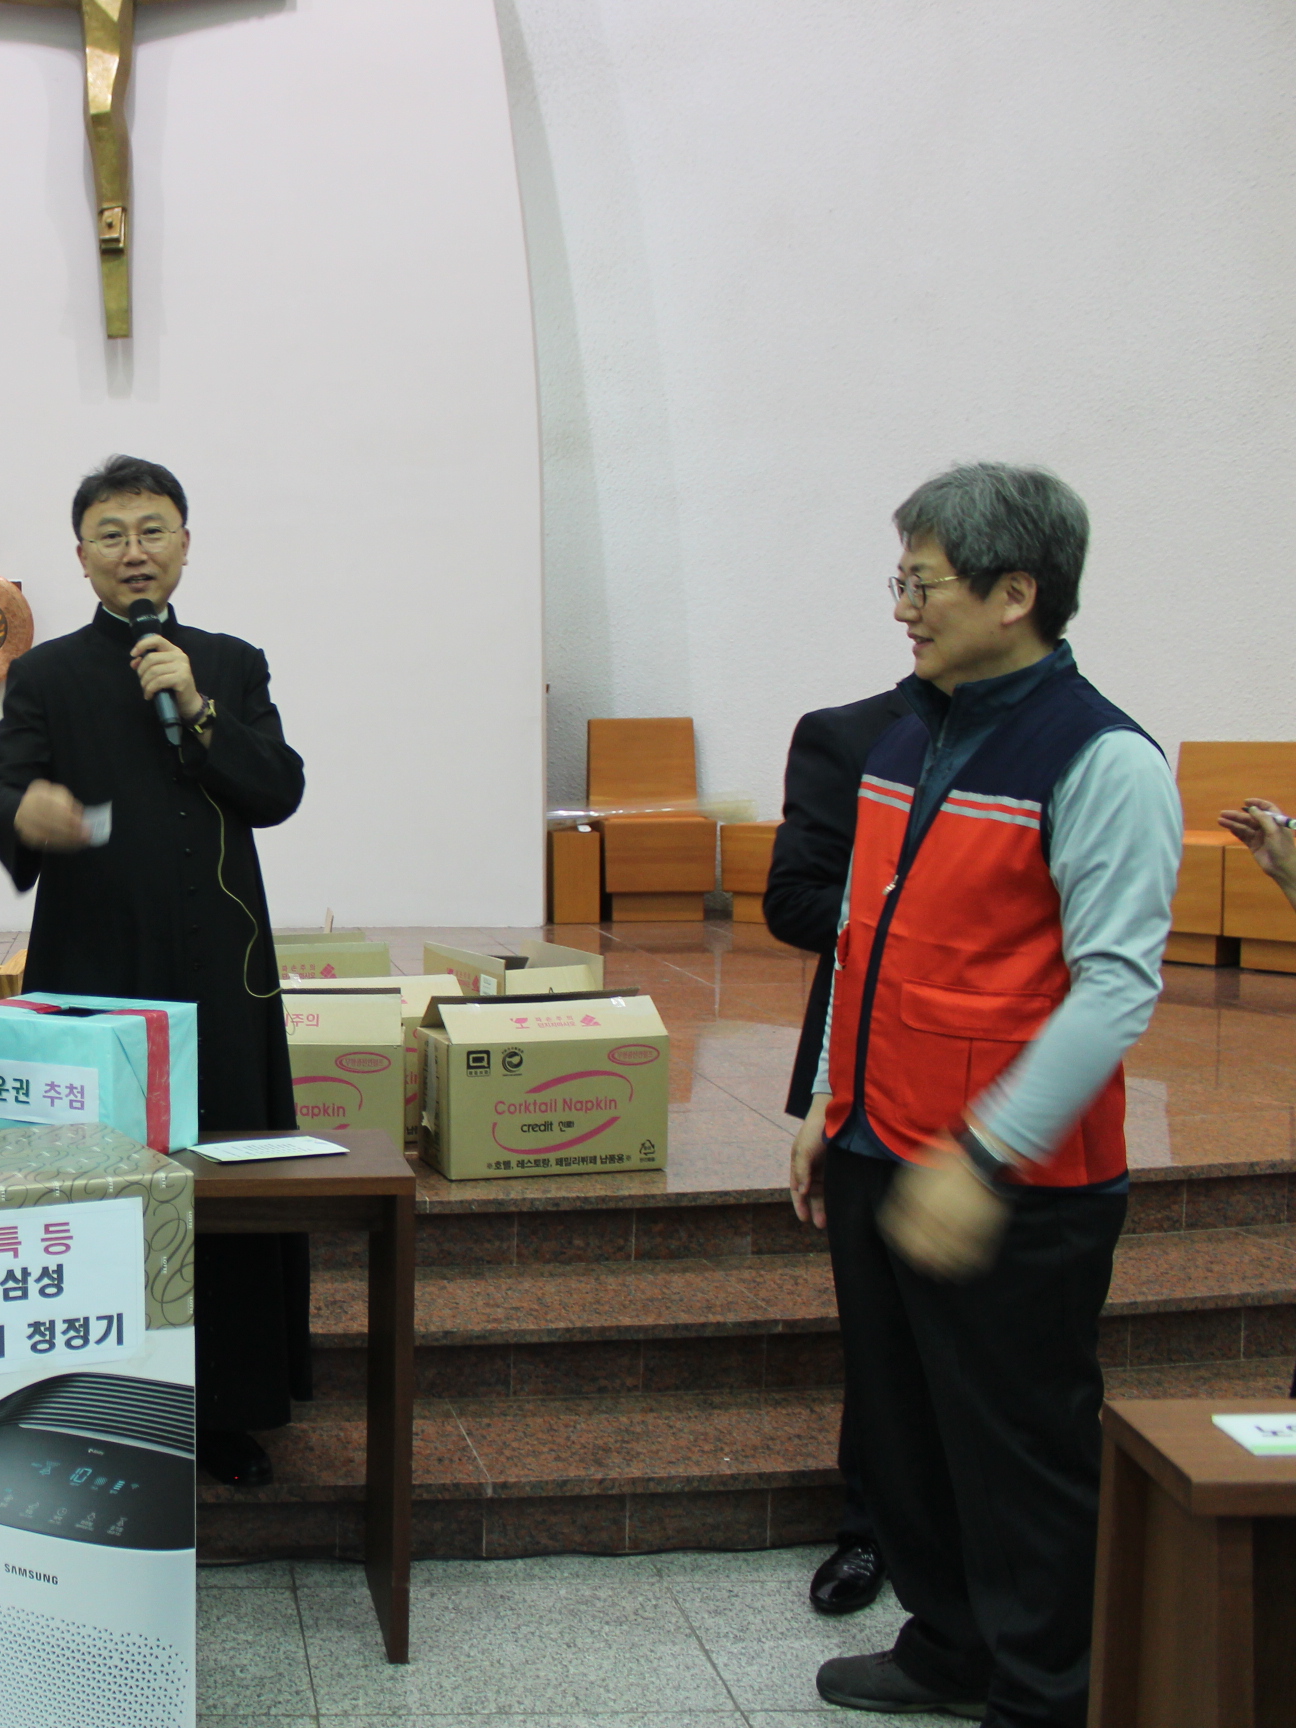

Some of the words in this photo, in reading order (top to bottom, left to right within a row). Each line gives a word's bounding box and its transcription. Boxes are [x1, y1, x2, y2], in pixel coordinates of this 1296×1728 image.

[42, 1081, 85, 1110] 추첨
[494, 1099, 557, 1115] Corktail
[562, 1096, 617, 1114] Napkin
[520, 1120, 553, 1133] credit
[0, 1263, 64, 1302] 삼성
[26, 1312, 124, 1354] 청정기
[4, 1563, 58, 1585] SAMSUNG
